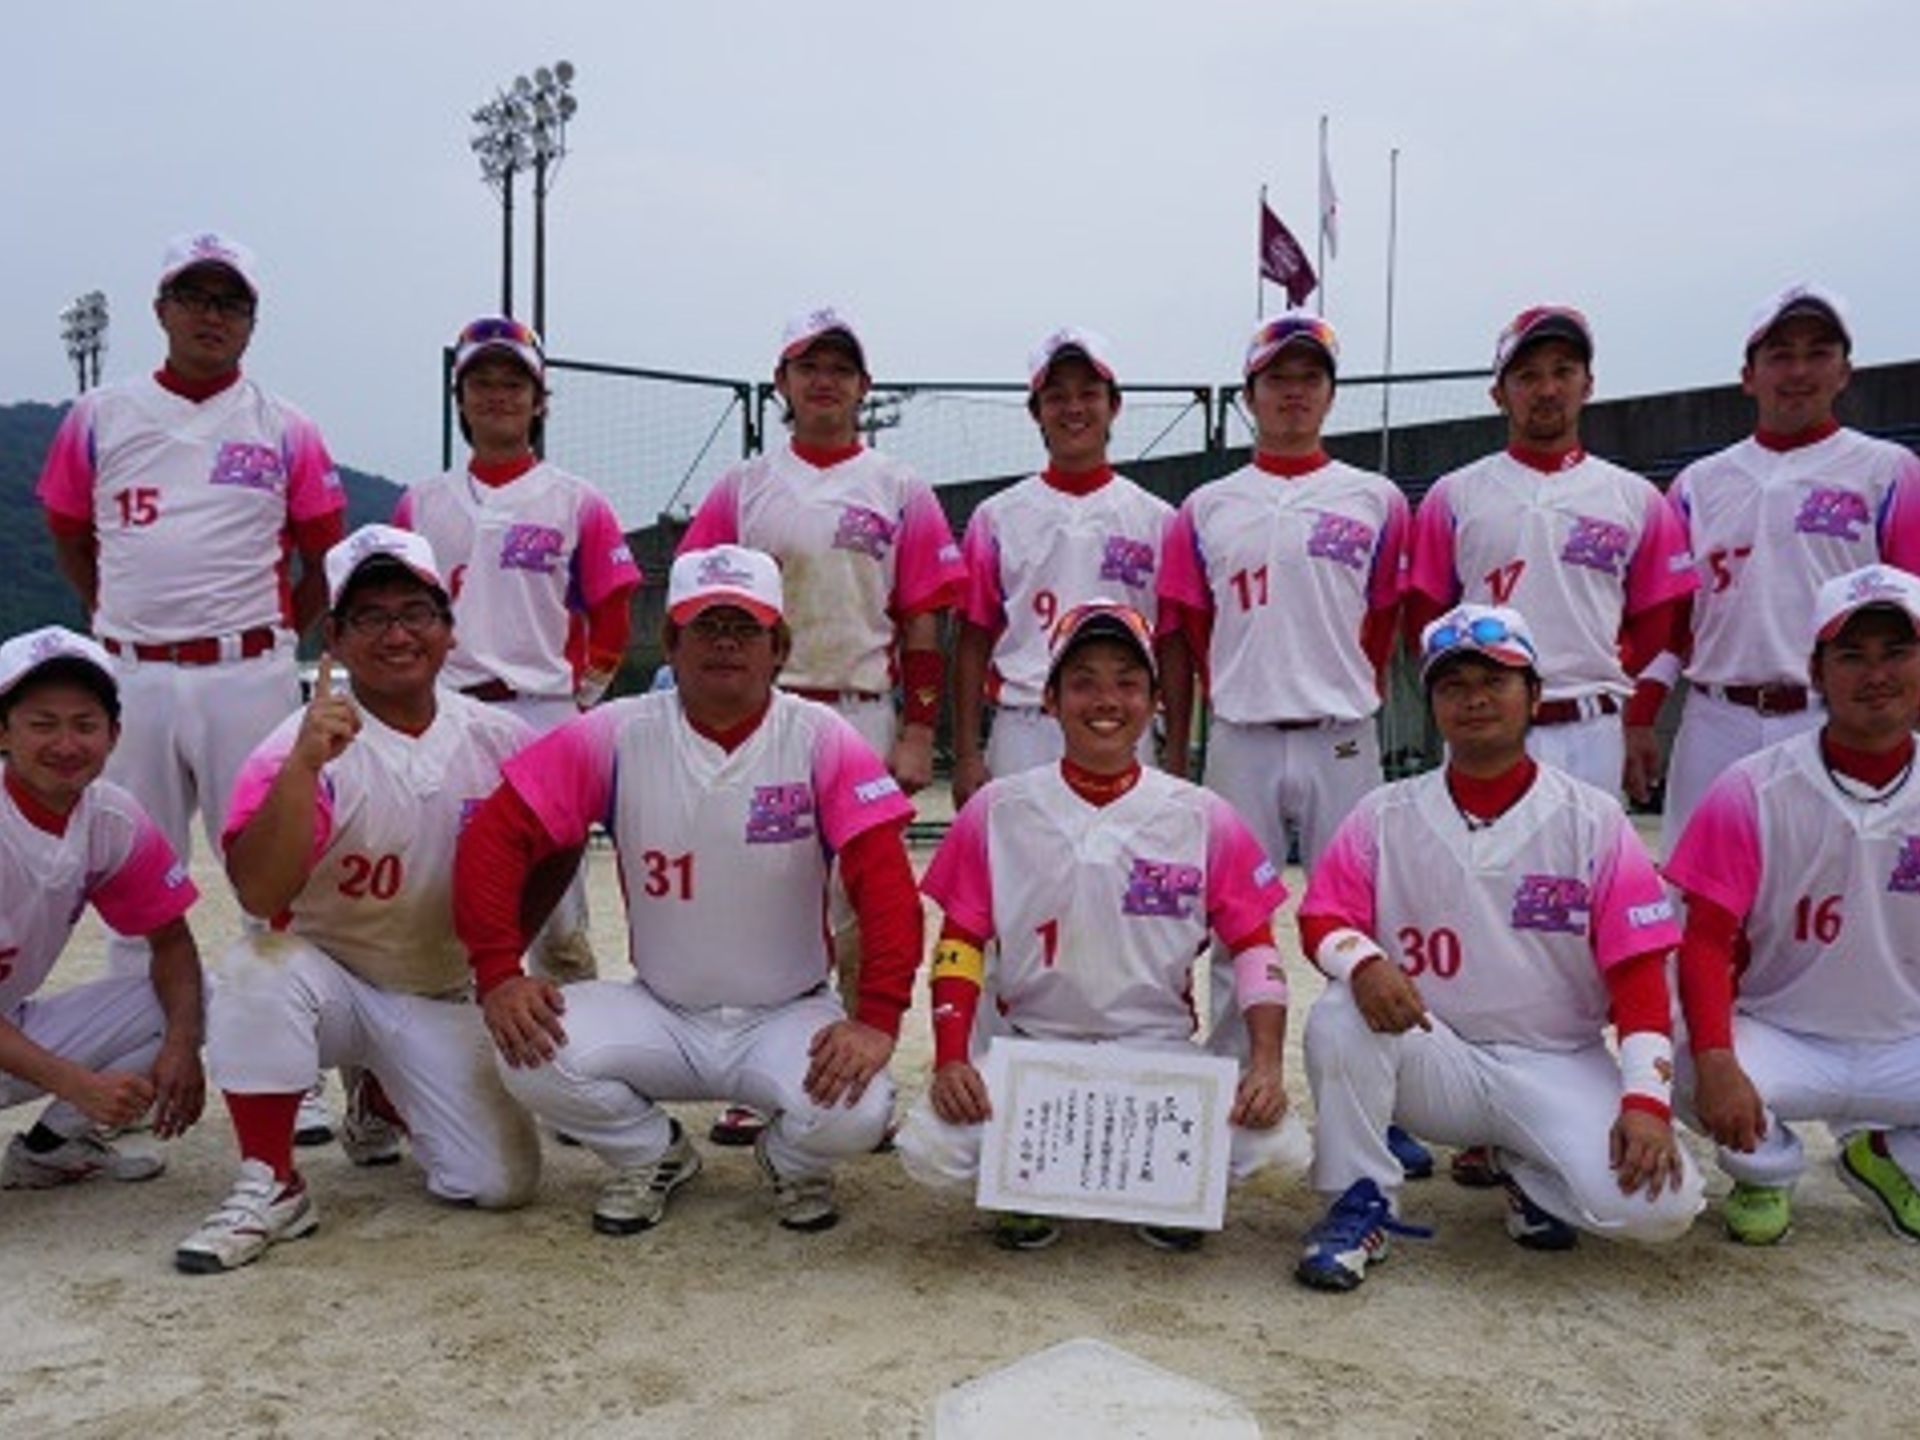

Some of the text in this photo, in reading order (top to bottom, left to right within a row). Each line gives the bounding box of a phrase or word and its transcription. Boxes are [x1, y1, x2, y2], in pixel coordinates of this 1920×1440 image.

[116, 488, 160, 526] 15
[1230, 565, 1268, 612] 11
[1485, 560, 1525, 605] 17
[1033, 591, 1057, 630] 9
[339, 854, 403, 901] 20
[642, 850, 695, 900] 31
[1794, 895, 1844, 944] 16
[1036, 919, 1058, 968] 1
[1397, 926, 1463, 979] 30
